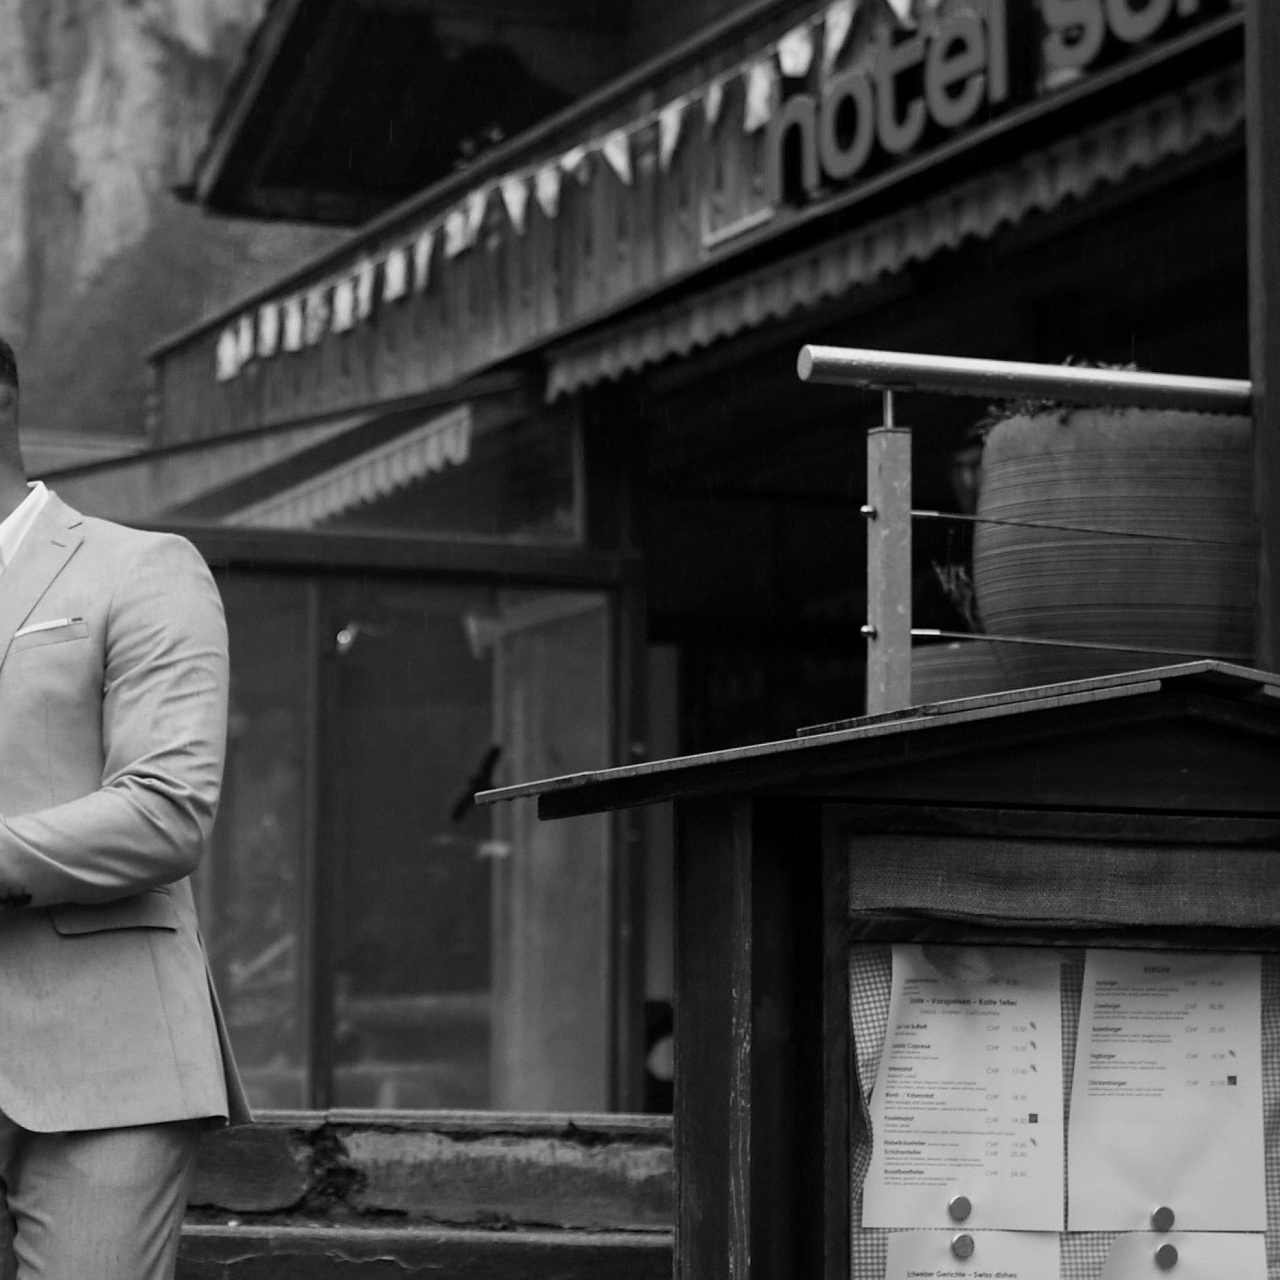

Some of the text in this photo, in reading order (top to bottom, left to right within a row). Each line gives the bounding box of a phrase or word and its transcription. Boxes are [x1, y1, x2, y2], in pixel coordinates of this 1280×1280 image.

[931, 997, 971, 1007] Vorspeisen
[906, 1271, 934, 1279] Schweizer
[936, 1270, 966, 1278] Gerichte
[973, 1271, 992, 1279] Swiss
[994, 1271, 1017, 1279] dishes
